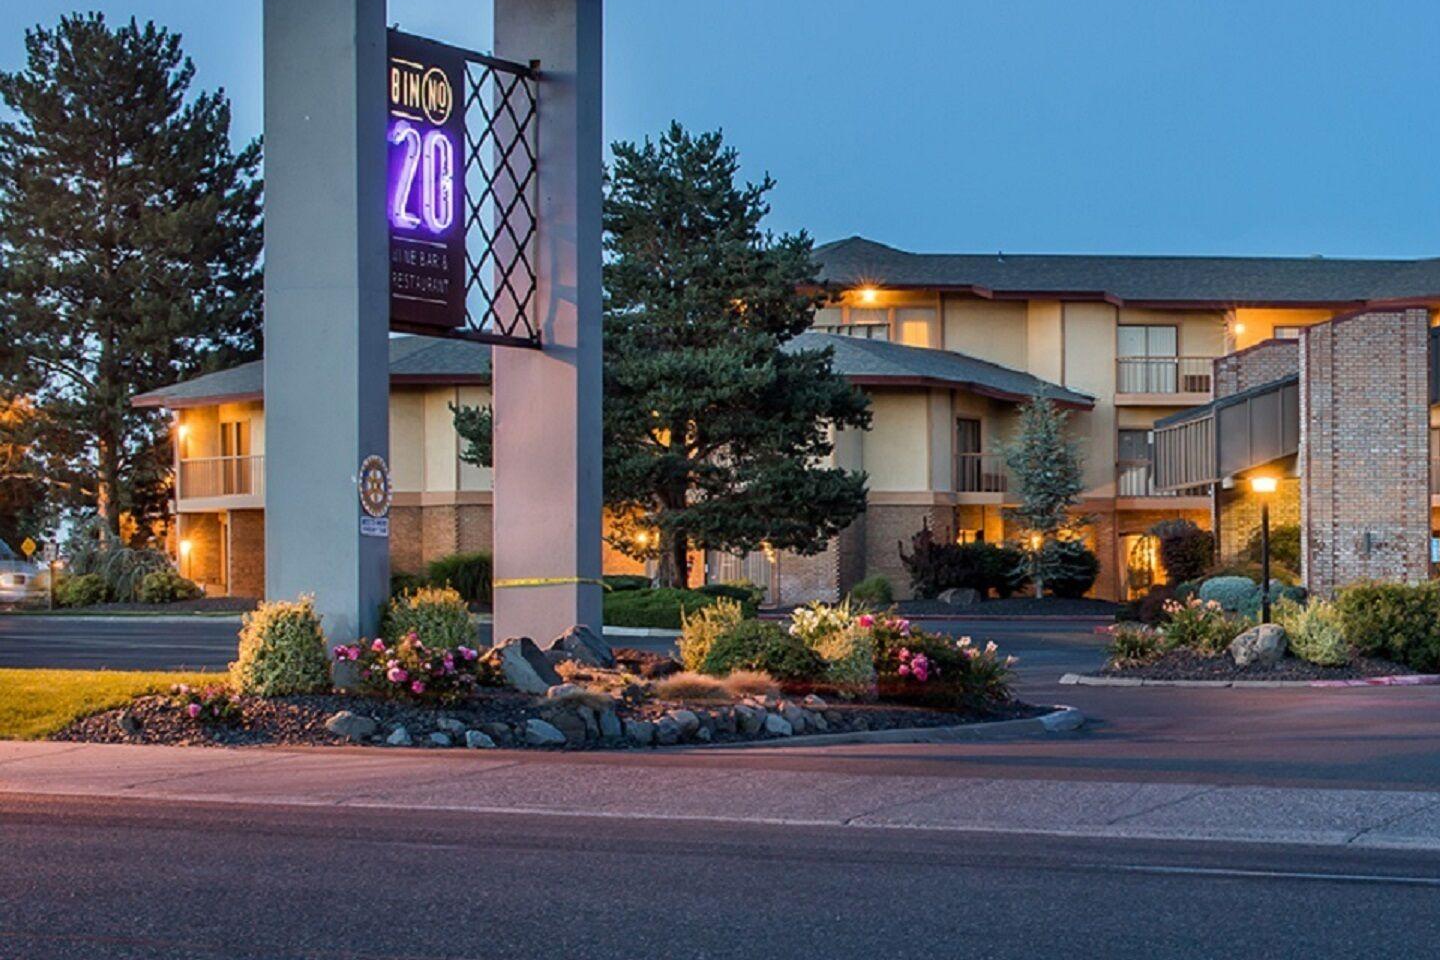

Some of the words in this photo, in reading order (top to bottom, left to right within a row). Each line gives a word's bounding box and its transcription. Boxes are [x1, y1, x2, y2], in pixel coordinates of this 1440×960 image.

[391, 67, 420, 109] BIN
[392, 120, 454, 233] 20
[420, 250, 440, 268] BAR
